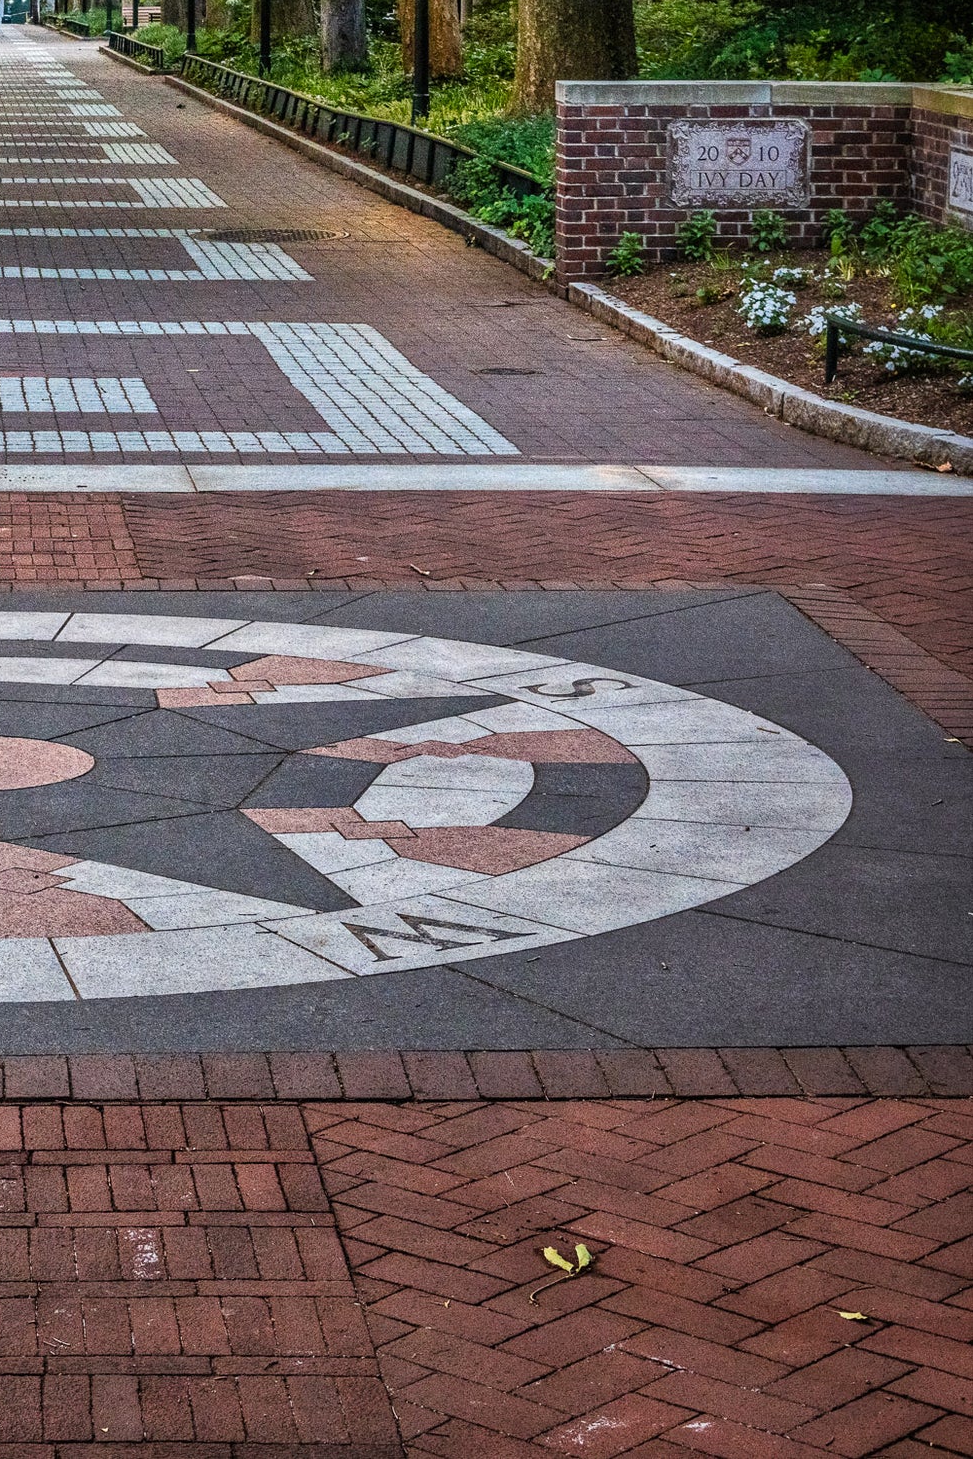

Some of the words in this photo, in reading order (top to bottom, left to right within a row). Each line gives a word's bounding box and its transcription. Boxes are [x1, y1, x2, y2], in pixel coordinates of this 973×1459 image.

[697, 145, 719, 162] 20
[759, 145, 780, 162] 10
[698, 172, 729, 188] IVY
[739, 172, 779, 188] DAY
[518, 677, 642, 698] S
[339, 912, 538, 963] W
